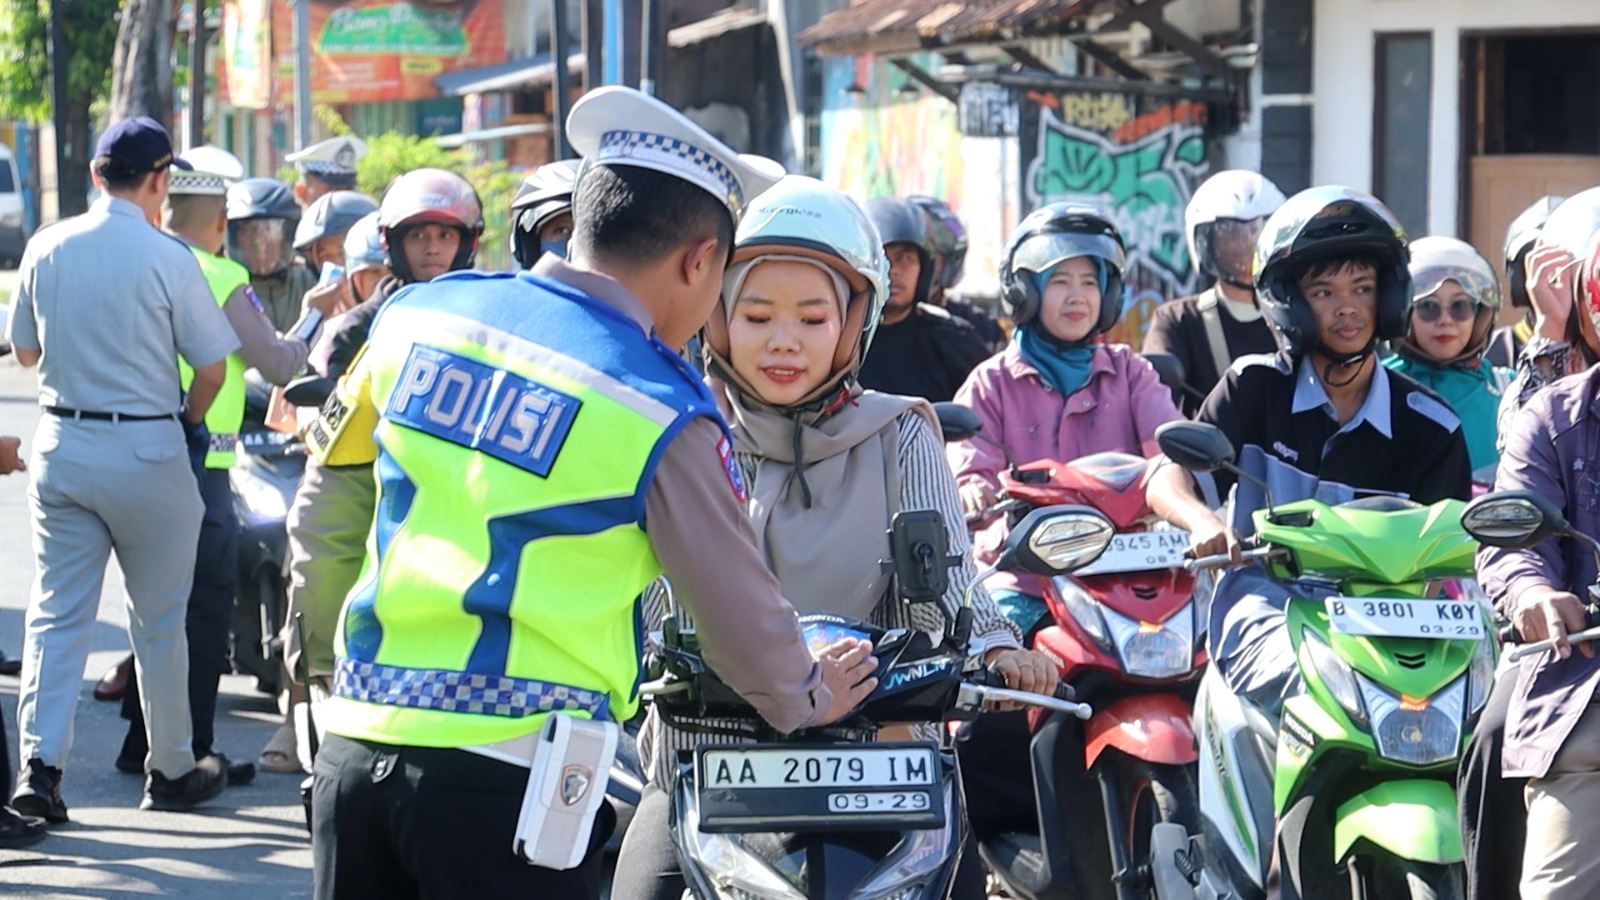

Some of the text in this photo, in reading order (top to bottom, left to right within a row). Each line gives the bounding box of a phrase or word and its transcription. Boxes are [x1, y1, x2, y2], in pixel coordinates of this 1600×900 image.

[394, 357, 566, 463] POLISI
[244, 433, 264, 446] AA
[798, 613, 847, 624] HONDA
[1333, 601, 1346, 616] B
[1363, 601, 1415, 618] 3801
[1284, 711, 1315, 747] HONDA
[715, 756, 928, 785] AA 2079 IM
